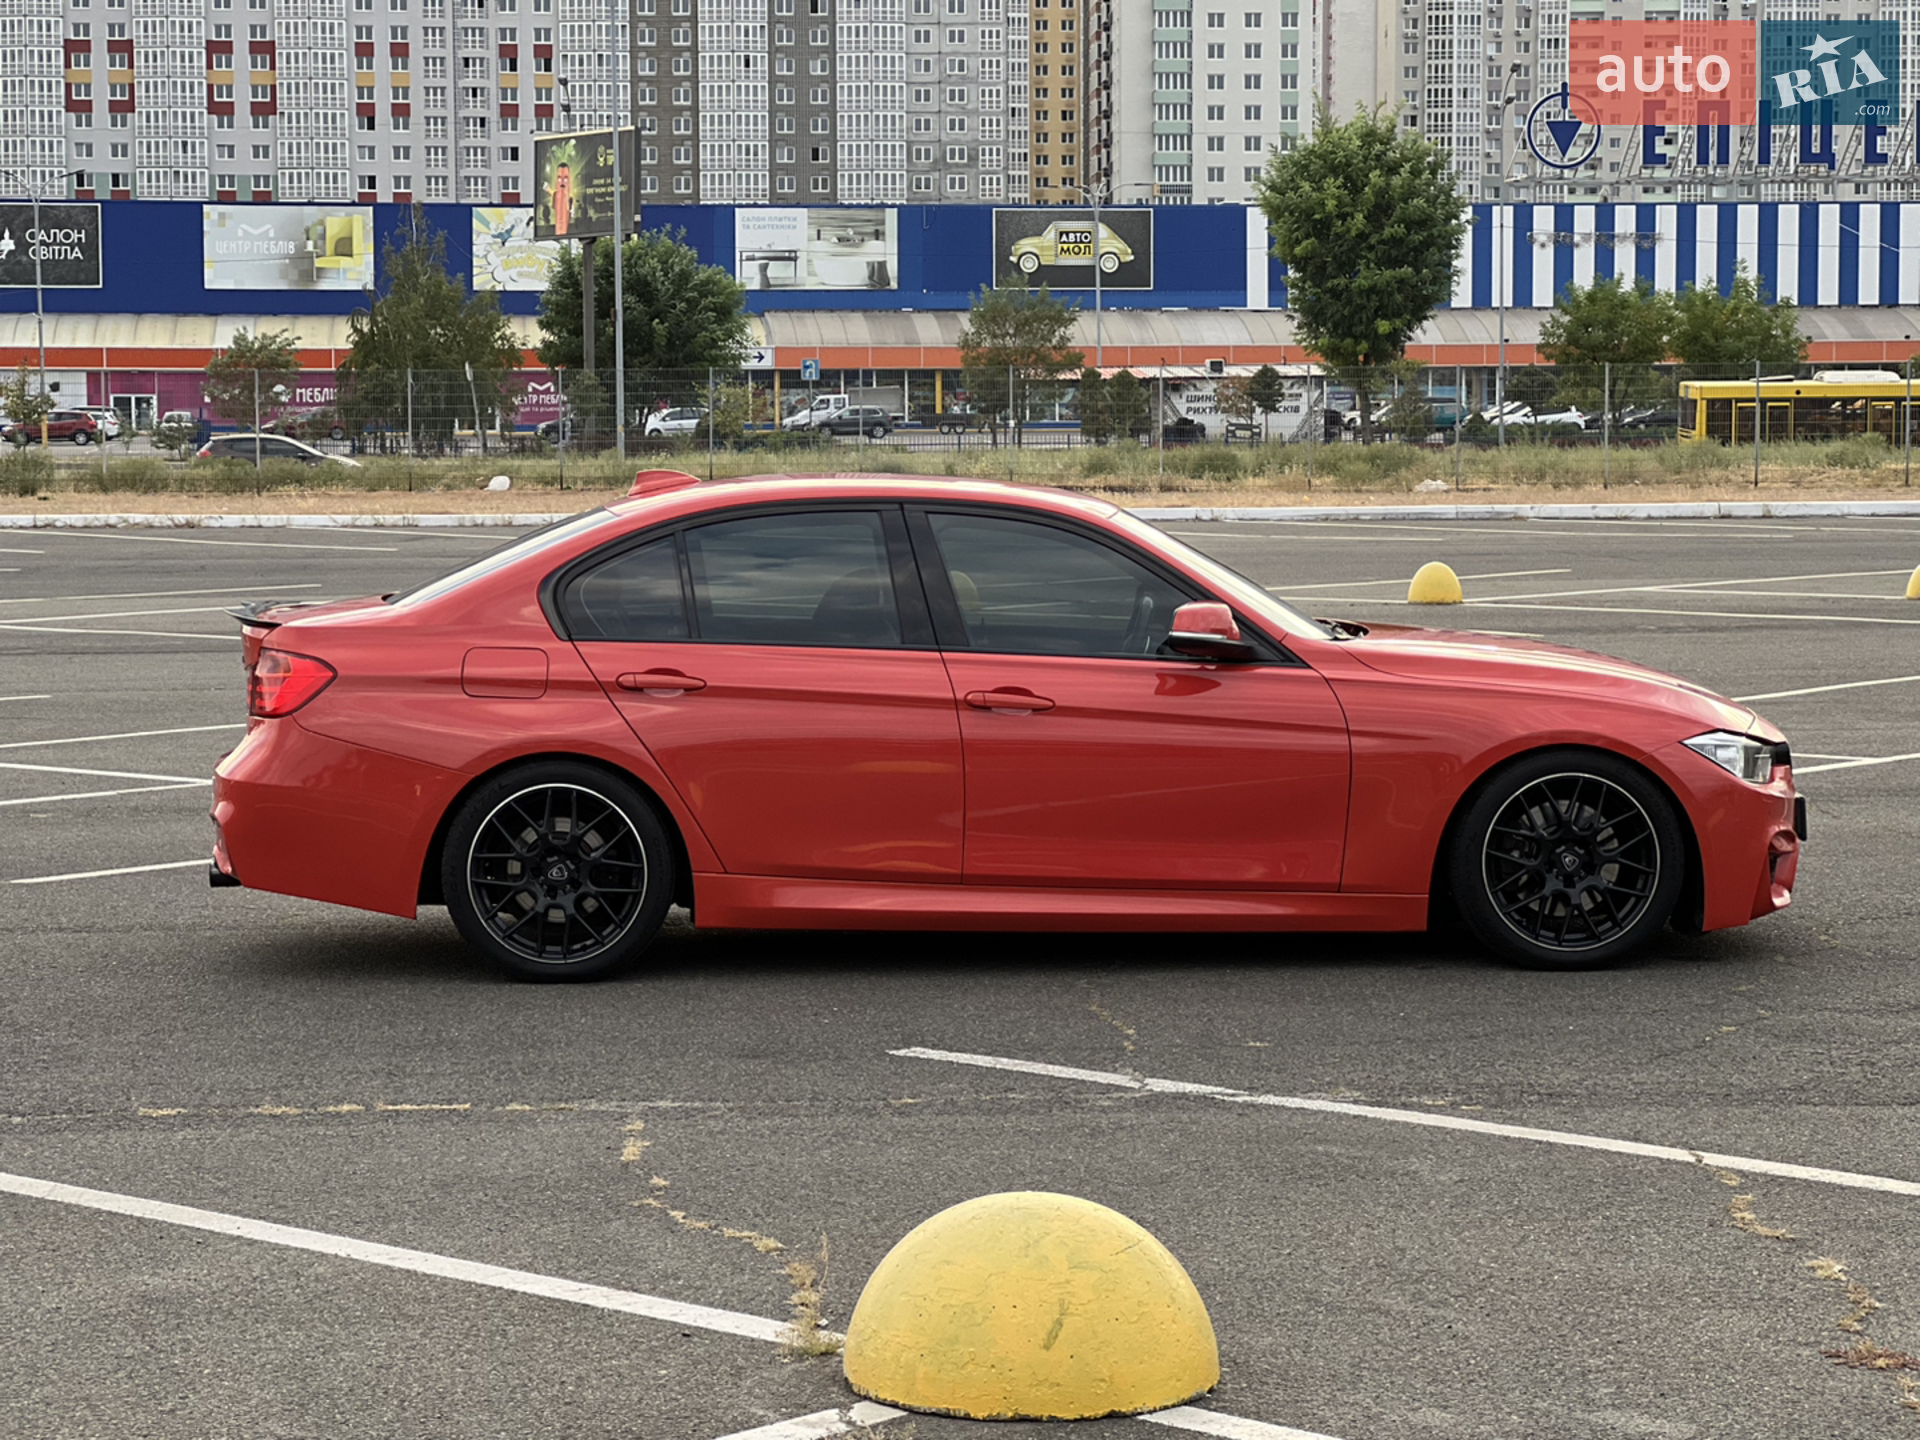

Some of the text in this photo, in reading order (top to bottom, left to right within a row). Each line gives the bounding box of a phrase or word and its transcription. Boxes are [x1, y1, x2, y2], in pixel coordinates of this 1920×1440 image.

[1642, 99, 1920, 171] ЕПІЦЕ
[25, 228, 86, 244] САЛОН
[1060, 232, 1091, 243] АВТО
[28, 245, 84, 260] СВІТЛА
[215, 240, 297, 255] ЦЕНТР МЕБЛІВ
[1059, 244, 1092, 256] МОЛ
[295, 387, 338, 402] МЕБЛІ
